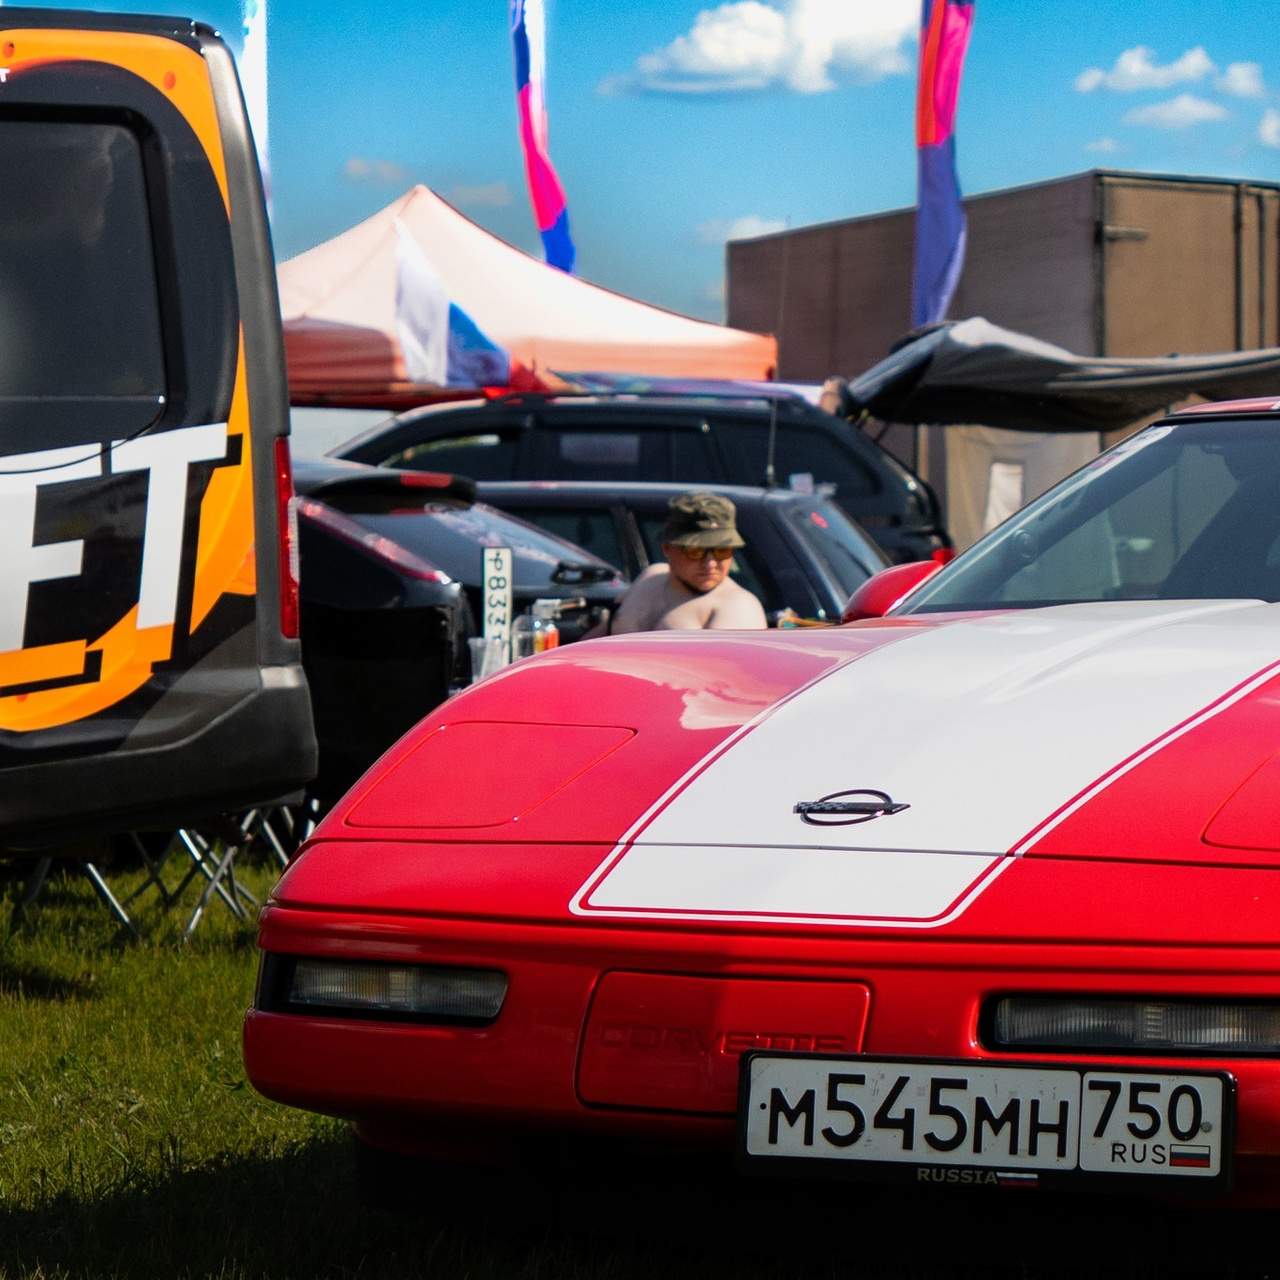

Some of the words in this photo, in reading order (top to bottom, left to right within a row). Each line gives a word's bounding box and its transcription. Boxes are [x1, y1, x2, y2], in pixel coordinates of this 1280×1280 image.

[601, 1022, 847, 1057] CORVETTE
[768, 1073, 1070, 1158] M545MH
[1088, 1080, 1203, 1142] 750
[1111, 1143, 1167, 1165] RUS
[916, 1167, 998, 1186] RUSSIA
